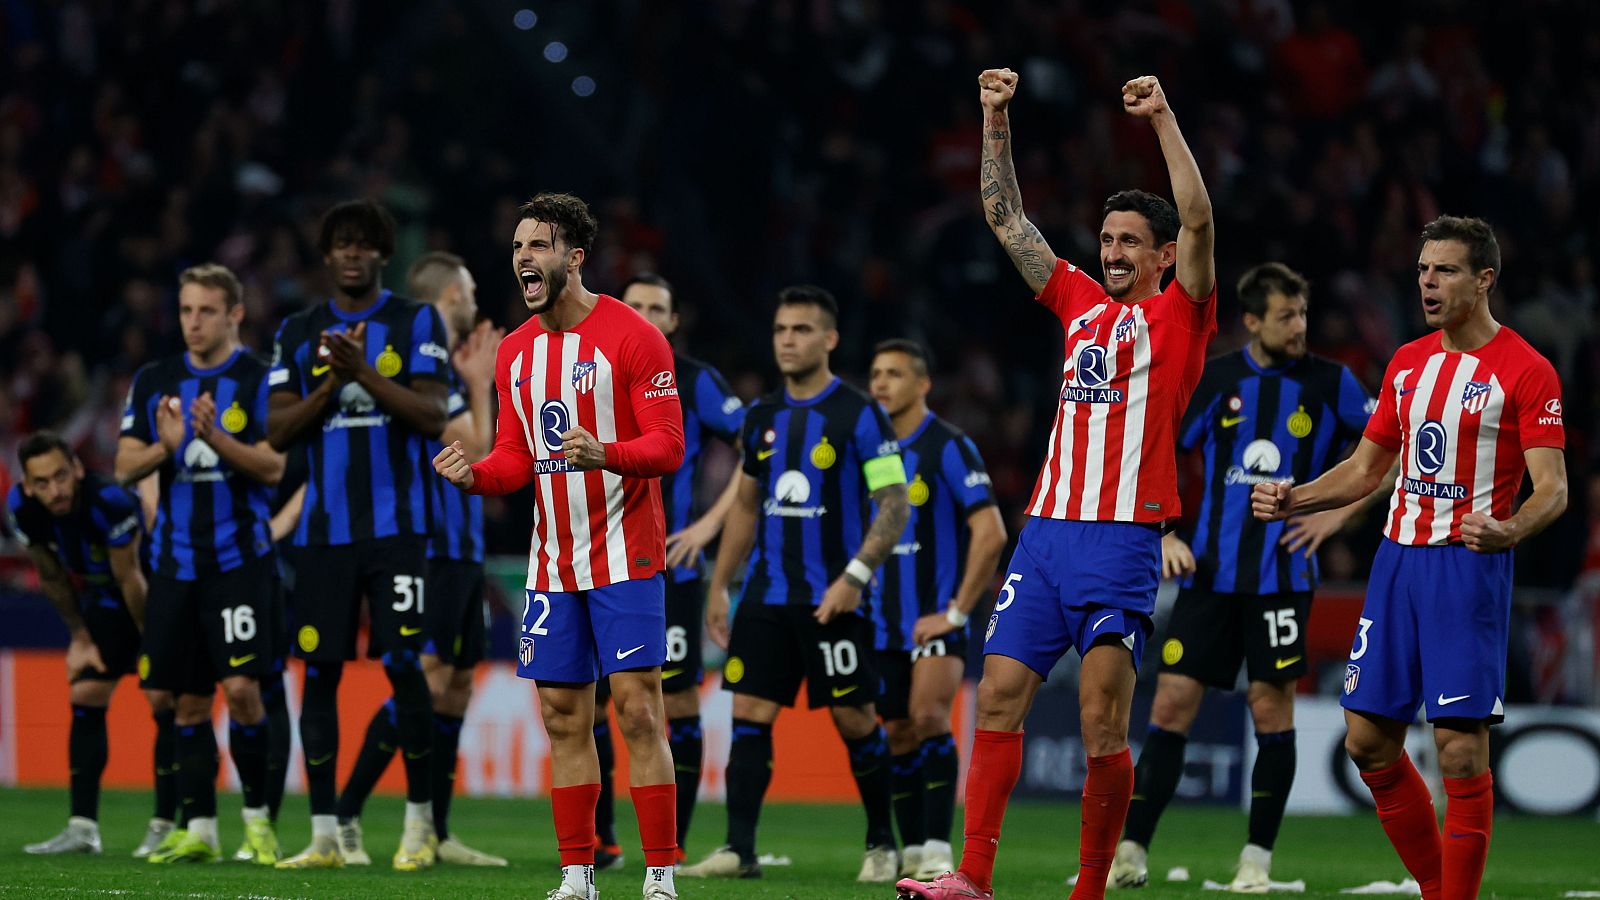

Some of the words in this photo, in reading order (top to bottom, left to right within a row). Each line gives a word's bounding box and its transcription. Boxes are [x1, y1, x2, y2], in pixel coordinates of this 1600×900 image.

[644, 388, 678, 399] HYUNDA
[1097, 390, 1121, 402] AIR
[1440, 485, 1465, 498] AIR
[392, 575, 425, 614] 31
[221, 604, 256, 643] 16
[1263, 608, 1299, 648] 15
[818, 639, 858, 677] 10
